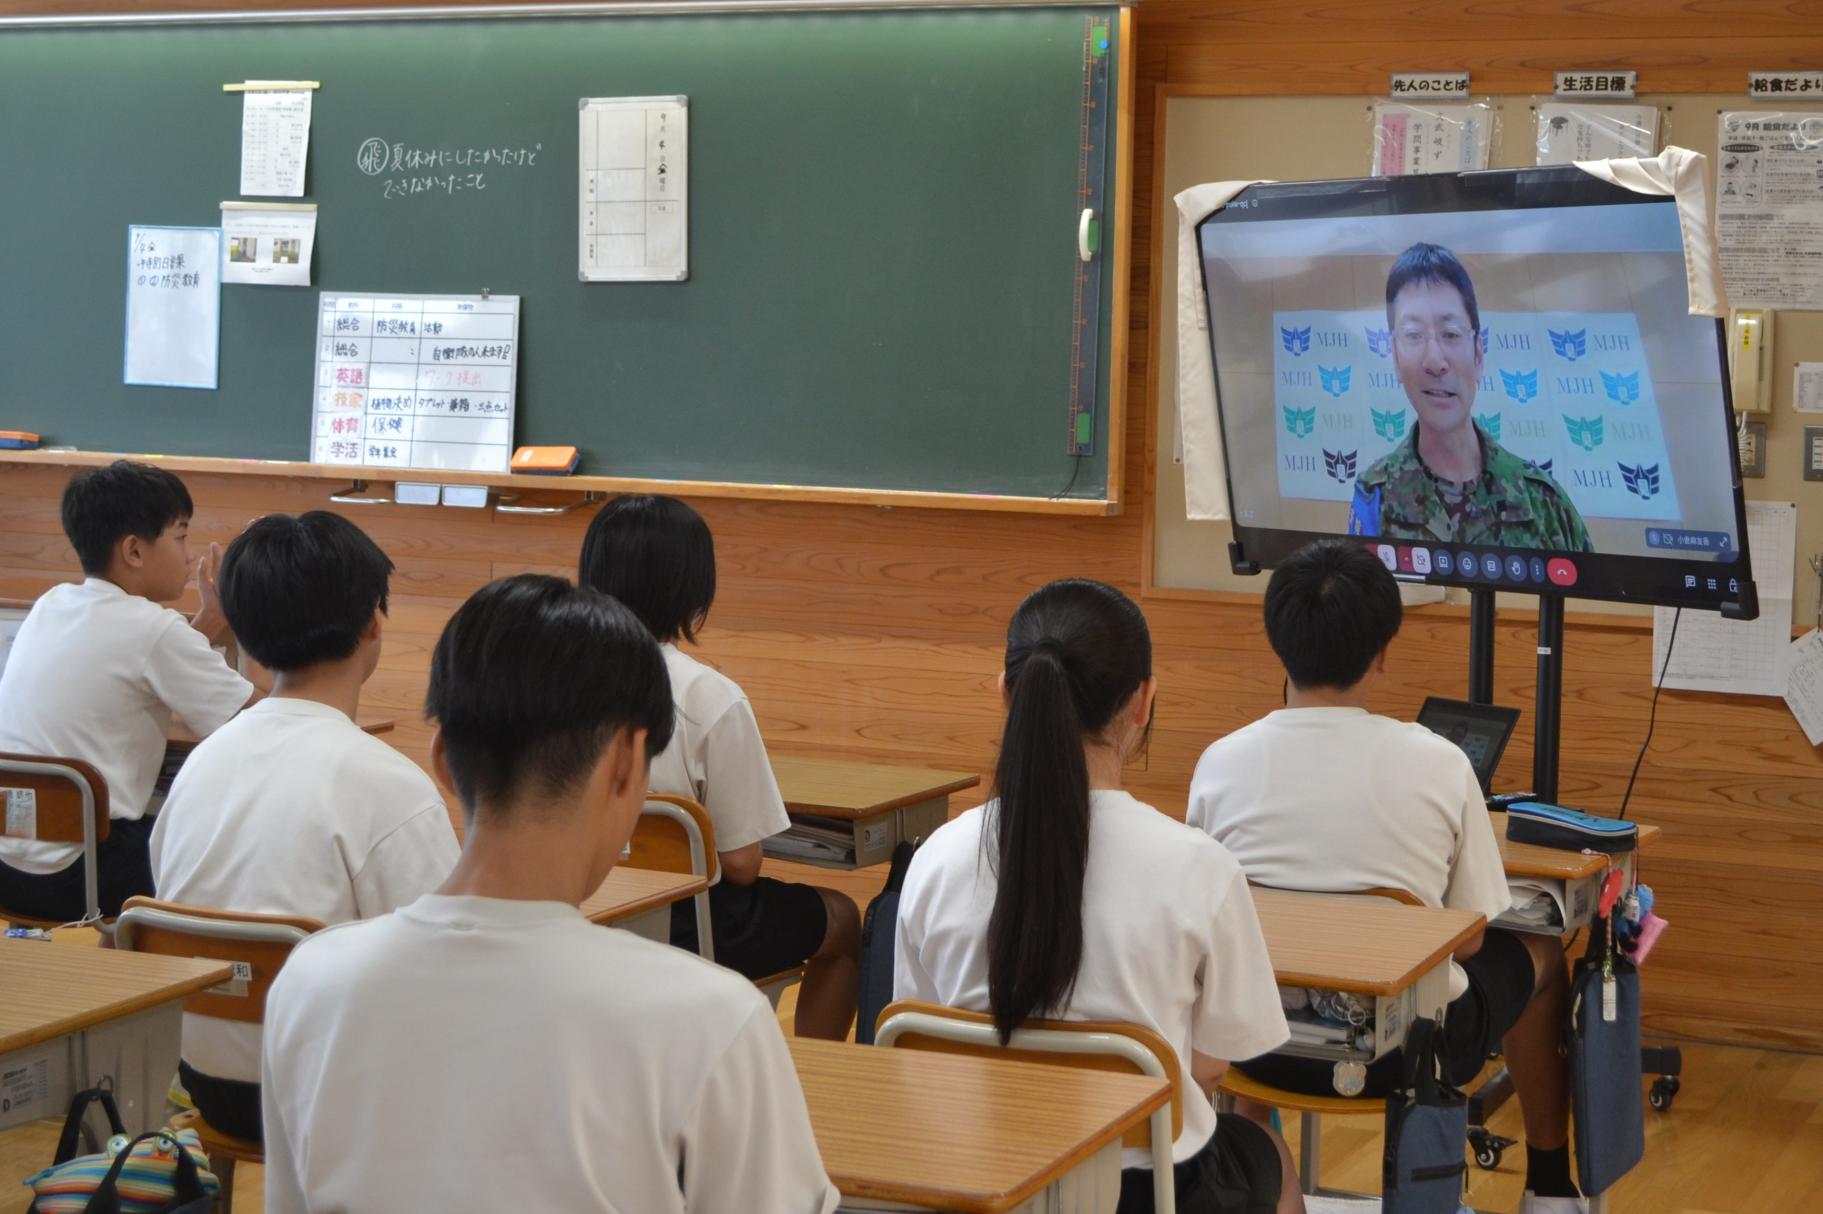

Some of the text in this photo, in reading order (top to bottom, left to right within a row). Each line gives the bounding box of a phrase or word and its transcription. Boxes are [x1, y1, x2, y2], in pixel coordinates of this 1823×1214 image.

[1393, 79, 1468, 92] 先人のことば
[1563, 76, 1626, 91] 生活目標
[383, 173, 486, 199] できなかったこと
[337, 317, 360, 332] 総合
[335, 342, 359, 357] 総合
[1317, 332, 1631, 351] MJH MJH MJH
[336, 368, 363, 384] 英語
[1281, 371, 1313, 387] MJH
[1556, 377, 1596, 394] MJH
[332, 416, 359, 433] 体育
[1509, 419, 1546, 438] MJH
[1612, 422, 1653, 441] MJH
[331, 441, 358, 458] 学活
[1284, 455, 1613, 488] MJH MJH
